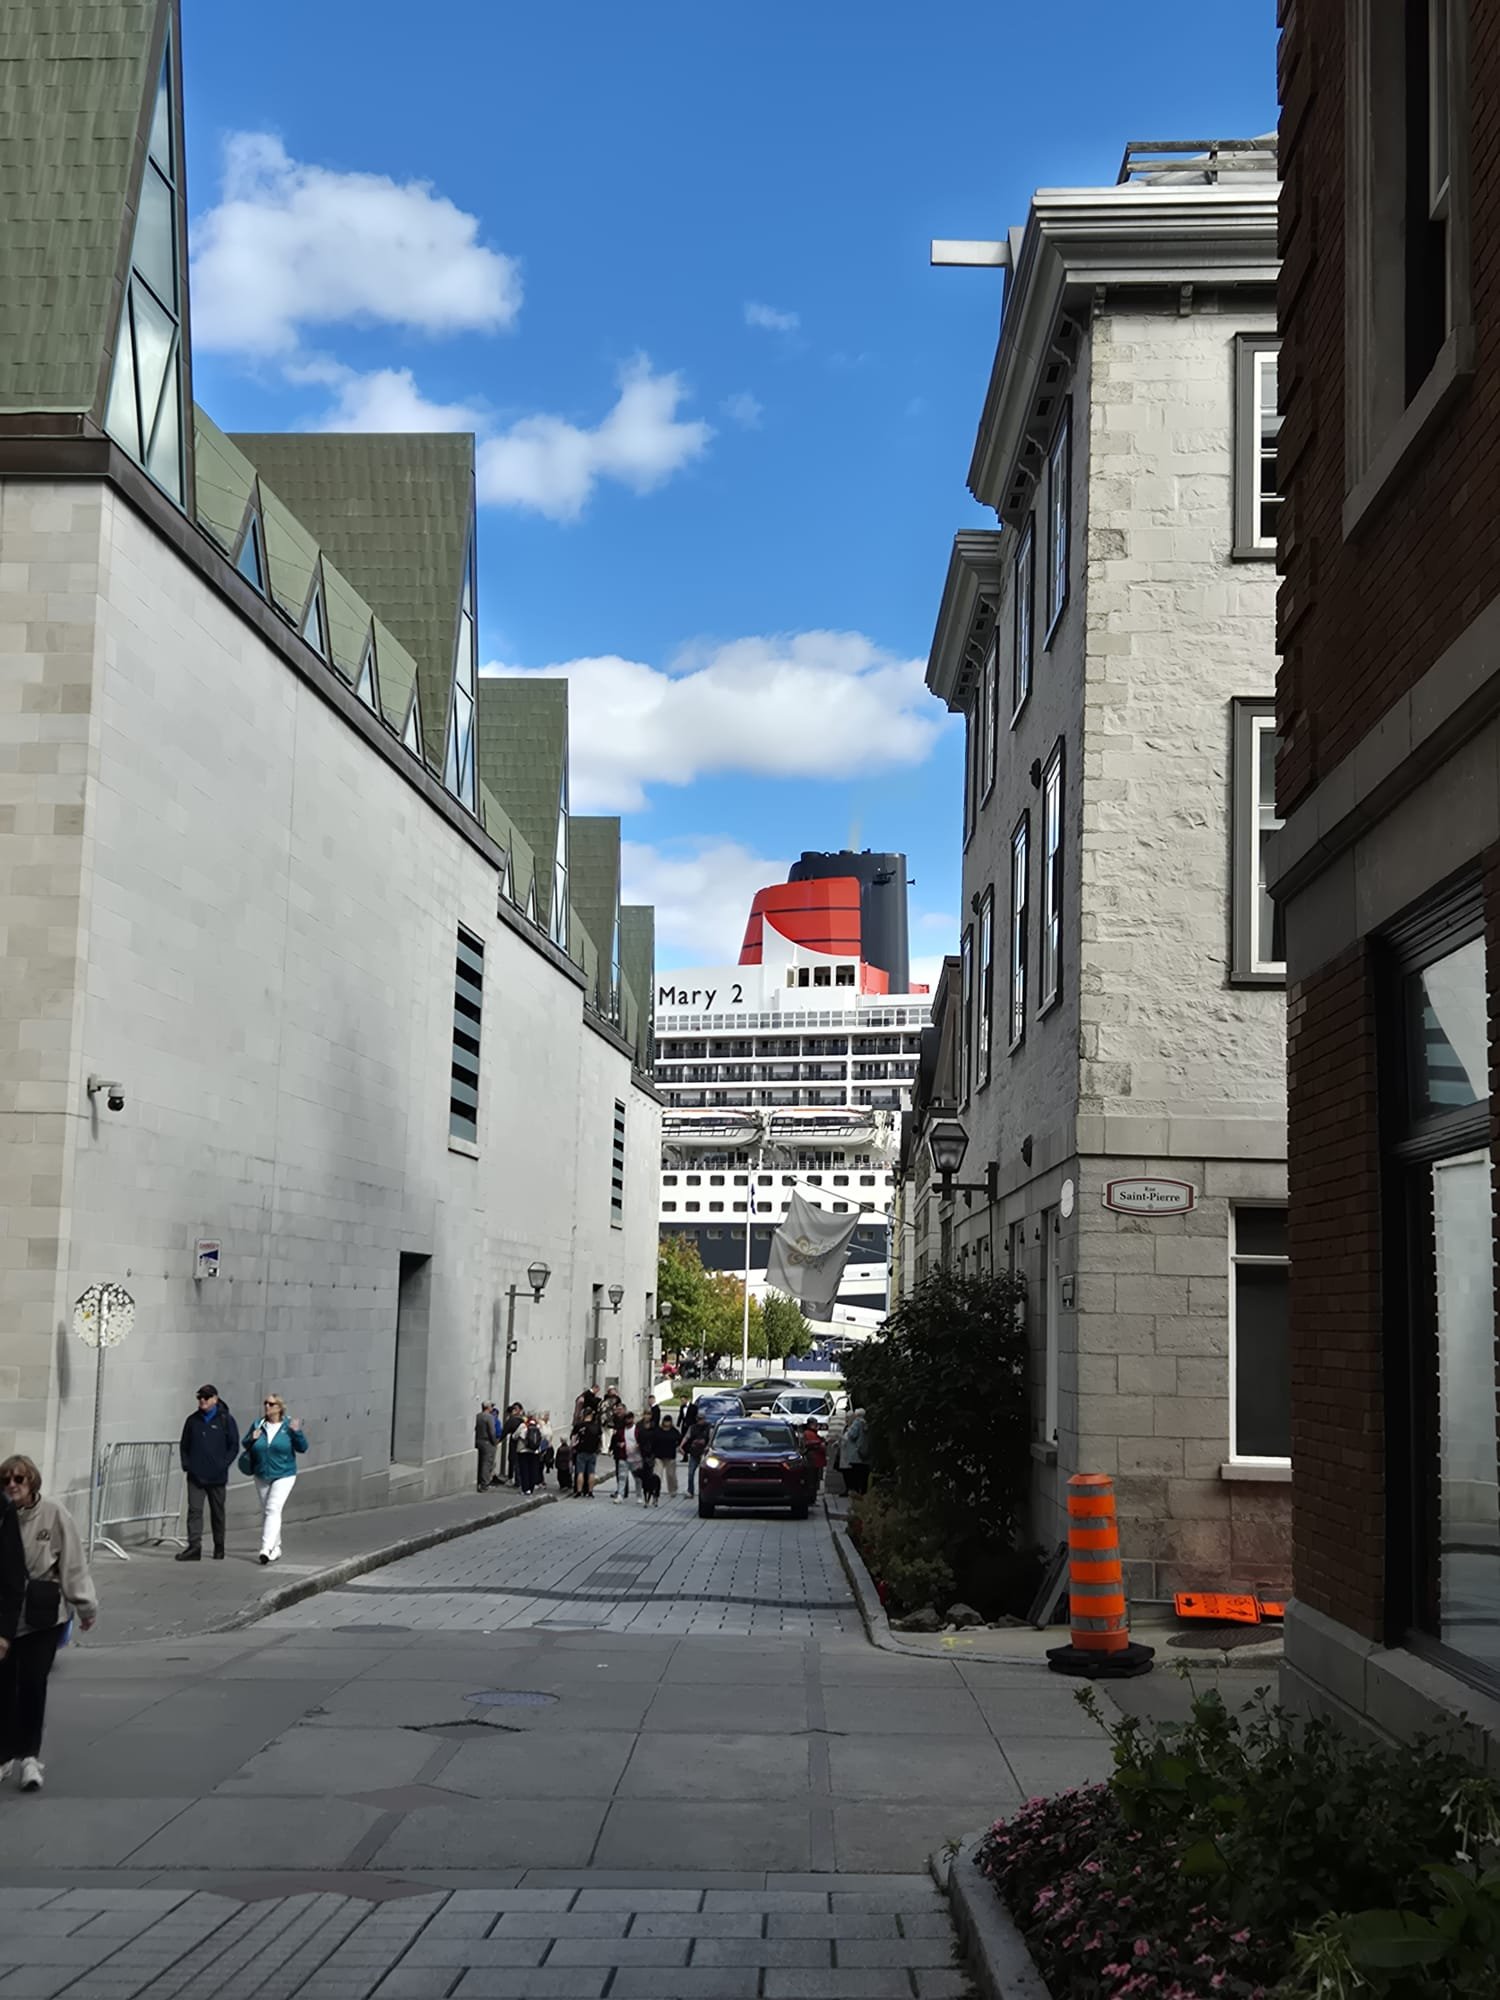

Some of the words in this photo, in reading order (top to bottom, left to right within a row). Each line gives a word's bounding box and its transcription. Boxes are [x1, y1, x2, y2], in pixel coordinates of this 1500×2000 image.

[659, 986, 717, 1010] Mary
[732, 984, 743, 1003] 2
[1119, 1191, 1181, 1202] Saint-Pierre
